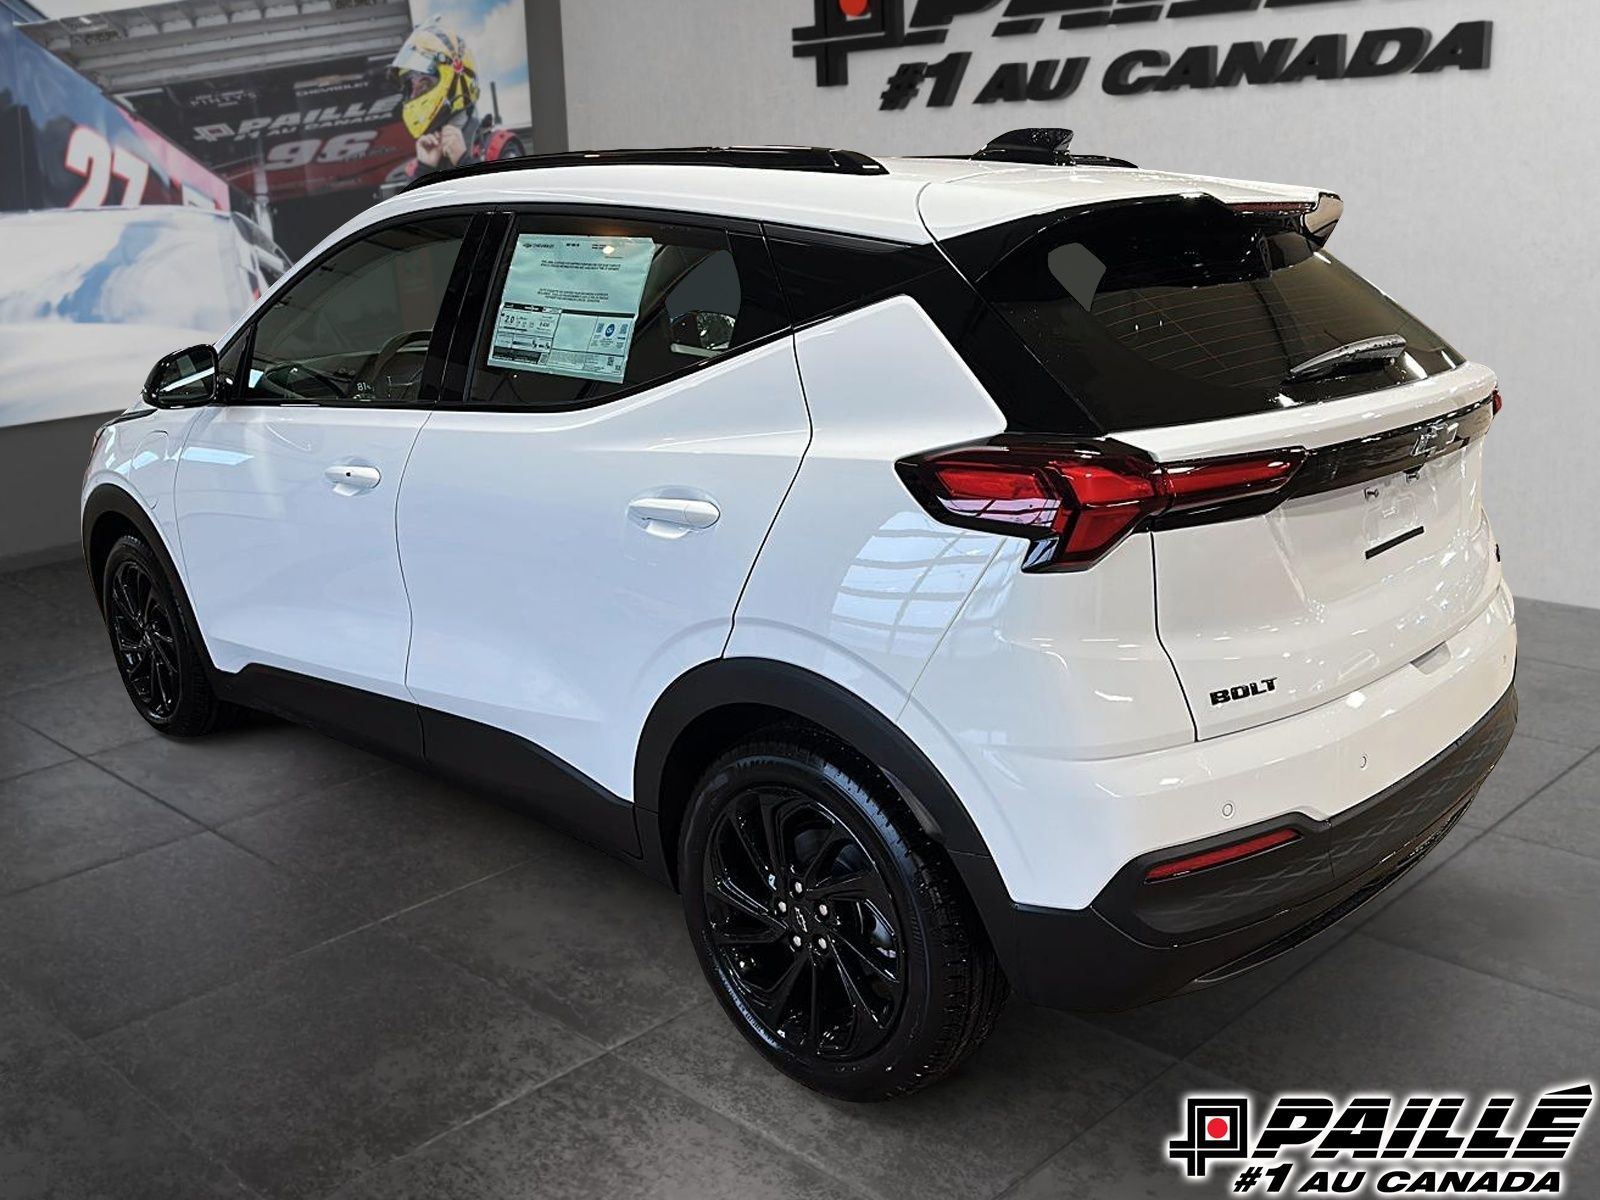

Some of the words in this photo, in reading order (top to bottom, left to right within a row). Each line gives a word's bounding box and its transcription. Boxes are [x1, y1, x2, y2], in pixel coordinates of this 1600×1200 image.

[878, 51, 973, 111] #1
[972, 56, 1091, 105] AU
[1101, 20, 1493, 95] CANADA
[303, 111, 393, 131] CANADA
[65, 124, 150, 210] 27
[263, 130, 378, 171] 96
[1209, 677, 1278, 706] BOLT
